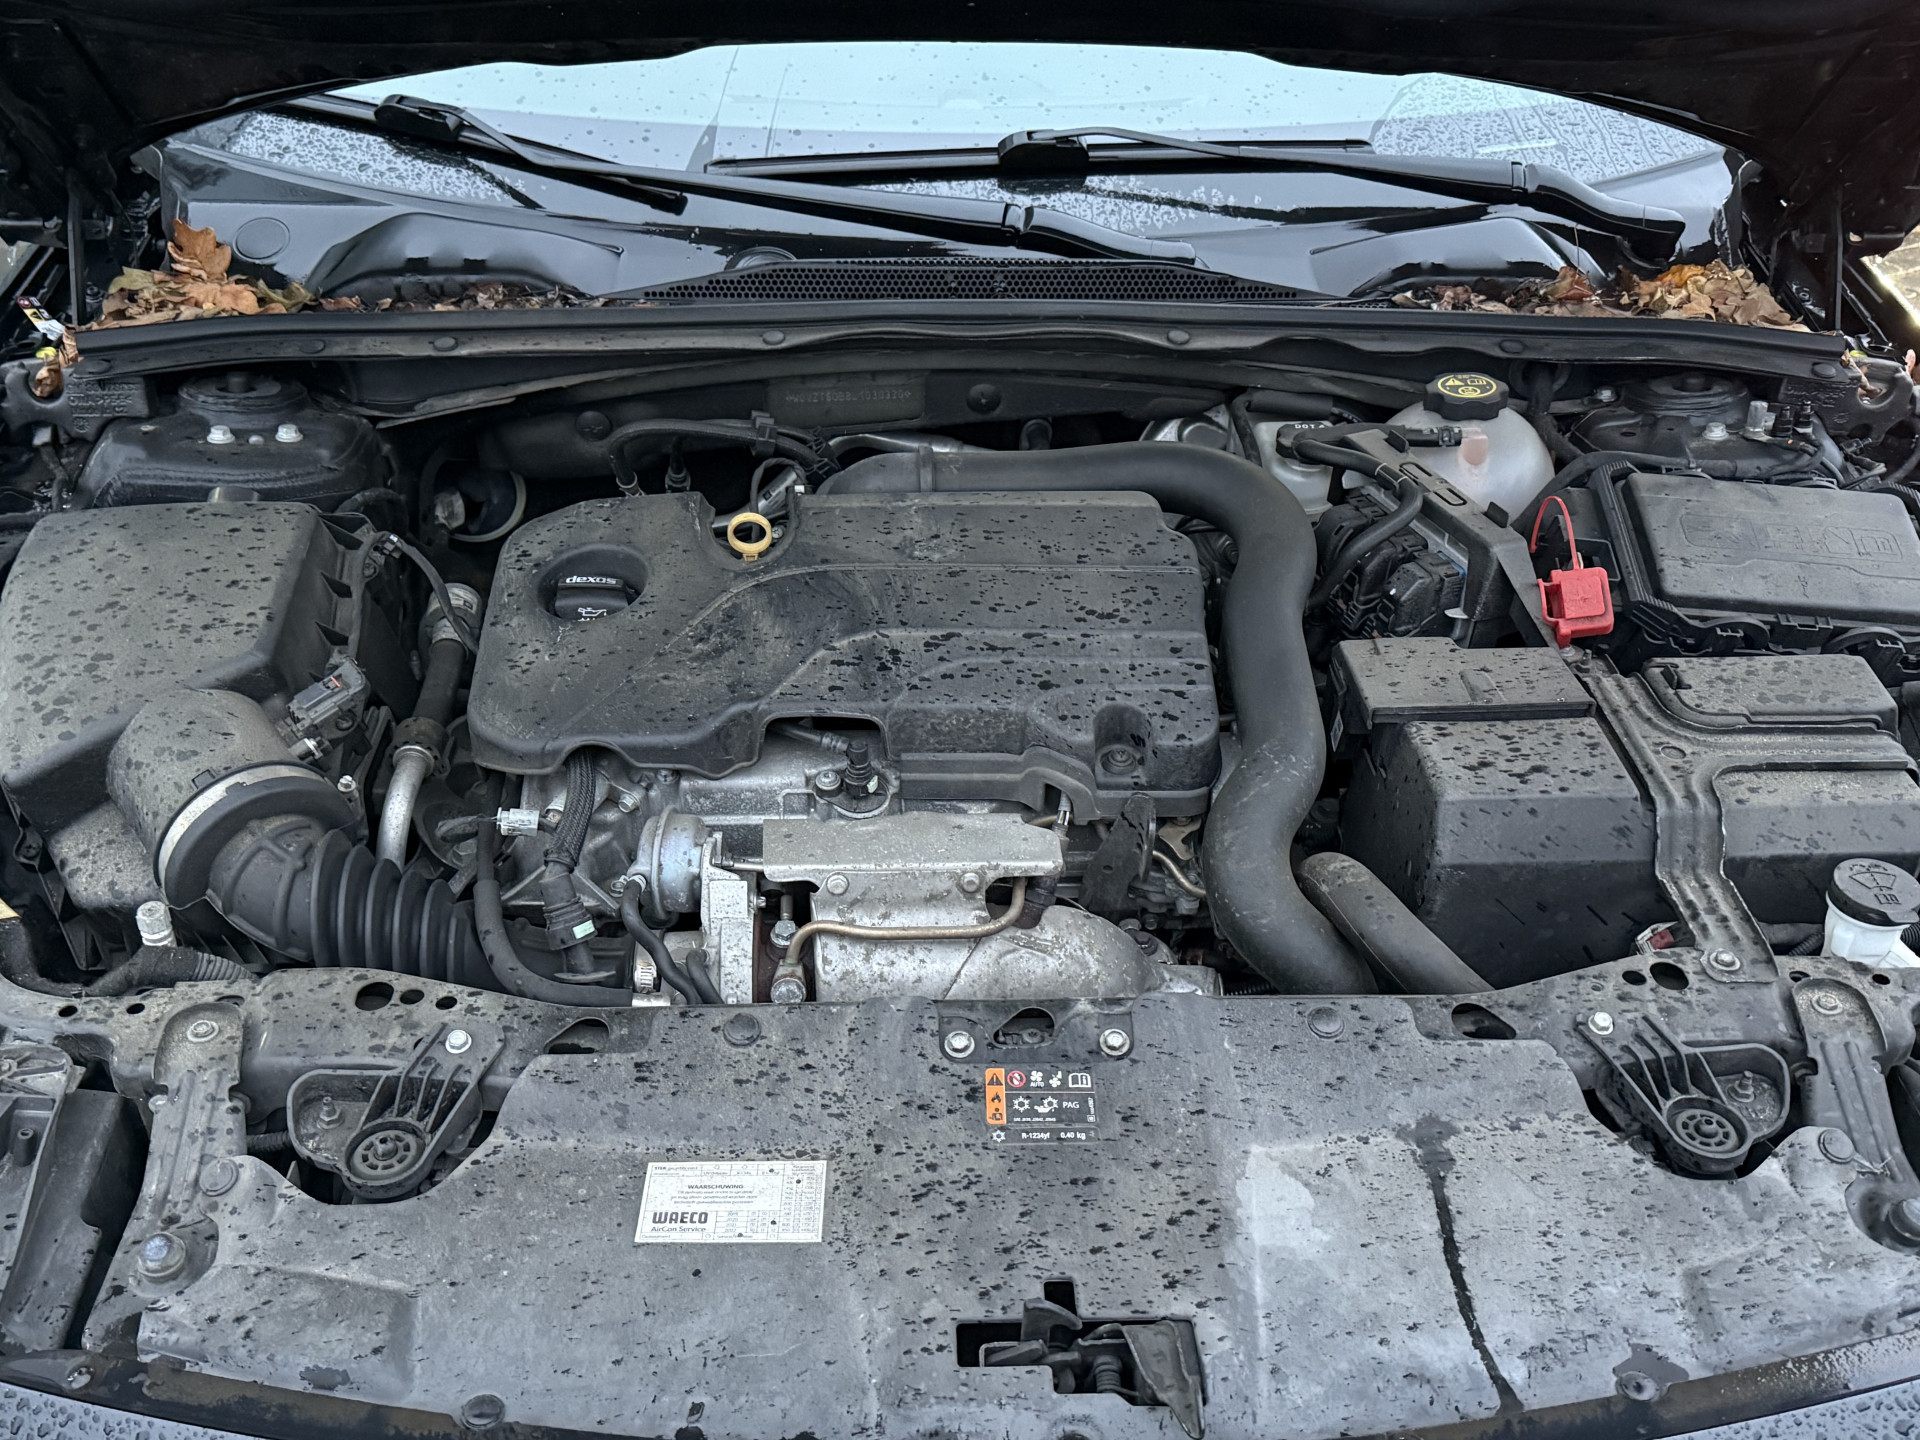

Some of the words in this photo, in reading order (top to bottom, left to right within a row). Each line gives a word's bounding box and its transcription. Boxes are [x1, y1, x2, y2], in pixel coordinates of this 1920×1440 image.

[565, 575, 617, 584] dexos
[1062, 1101, 1080, 1109] PAG
[1021, 1132, 1051, 1140] R-1234yf
[1076, 1131, 1086, 1140] kg
[652, 1211, 709, 1224] WAECO
